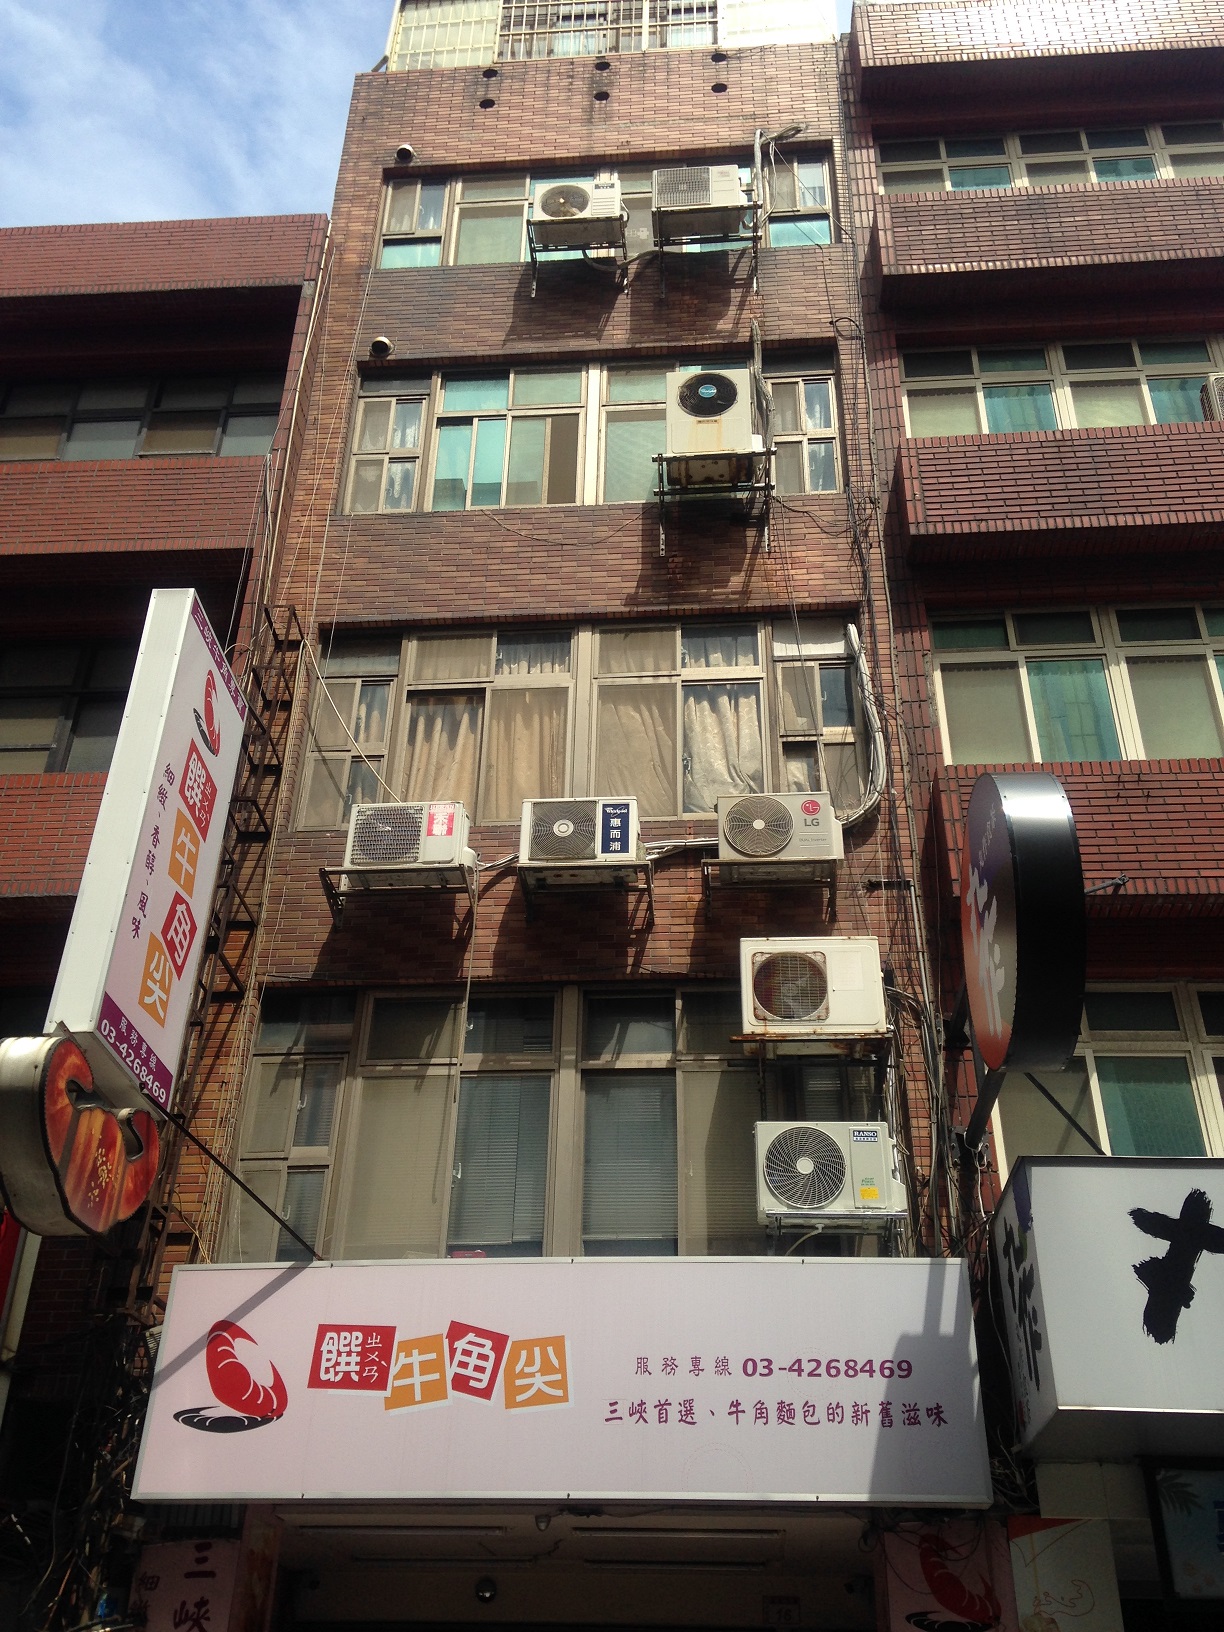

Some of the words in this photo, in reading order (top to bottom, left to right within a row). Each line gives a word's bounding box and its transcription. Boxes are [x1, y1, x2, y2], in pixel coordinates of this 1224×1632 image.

[609, 817, 622, 851] 惠而浦
[804, 818, 820, 827] LG
[101, 1018, 167, 1104] 03-4268469
[118, 1016, 157, 1072] 服務專線
[634, 1356, 733, 1377] 服務專線
[741, 1357, 913, 1379] 03-4268469
[604, 1398, 949, 1429] 三峽首選、牛角麵包的新舊滋味
[173, 1541, 217, 1632] 三峽
